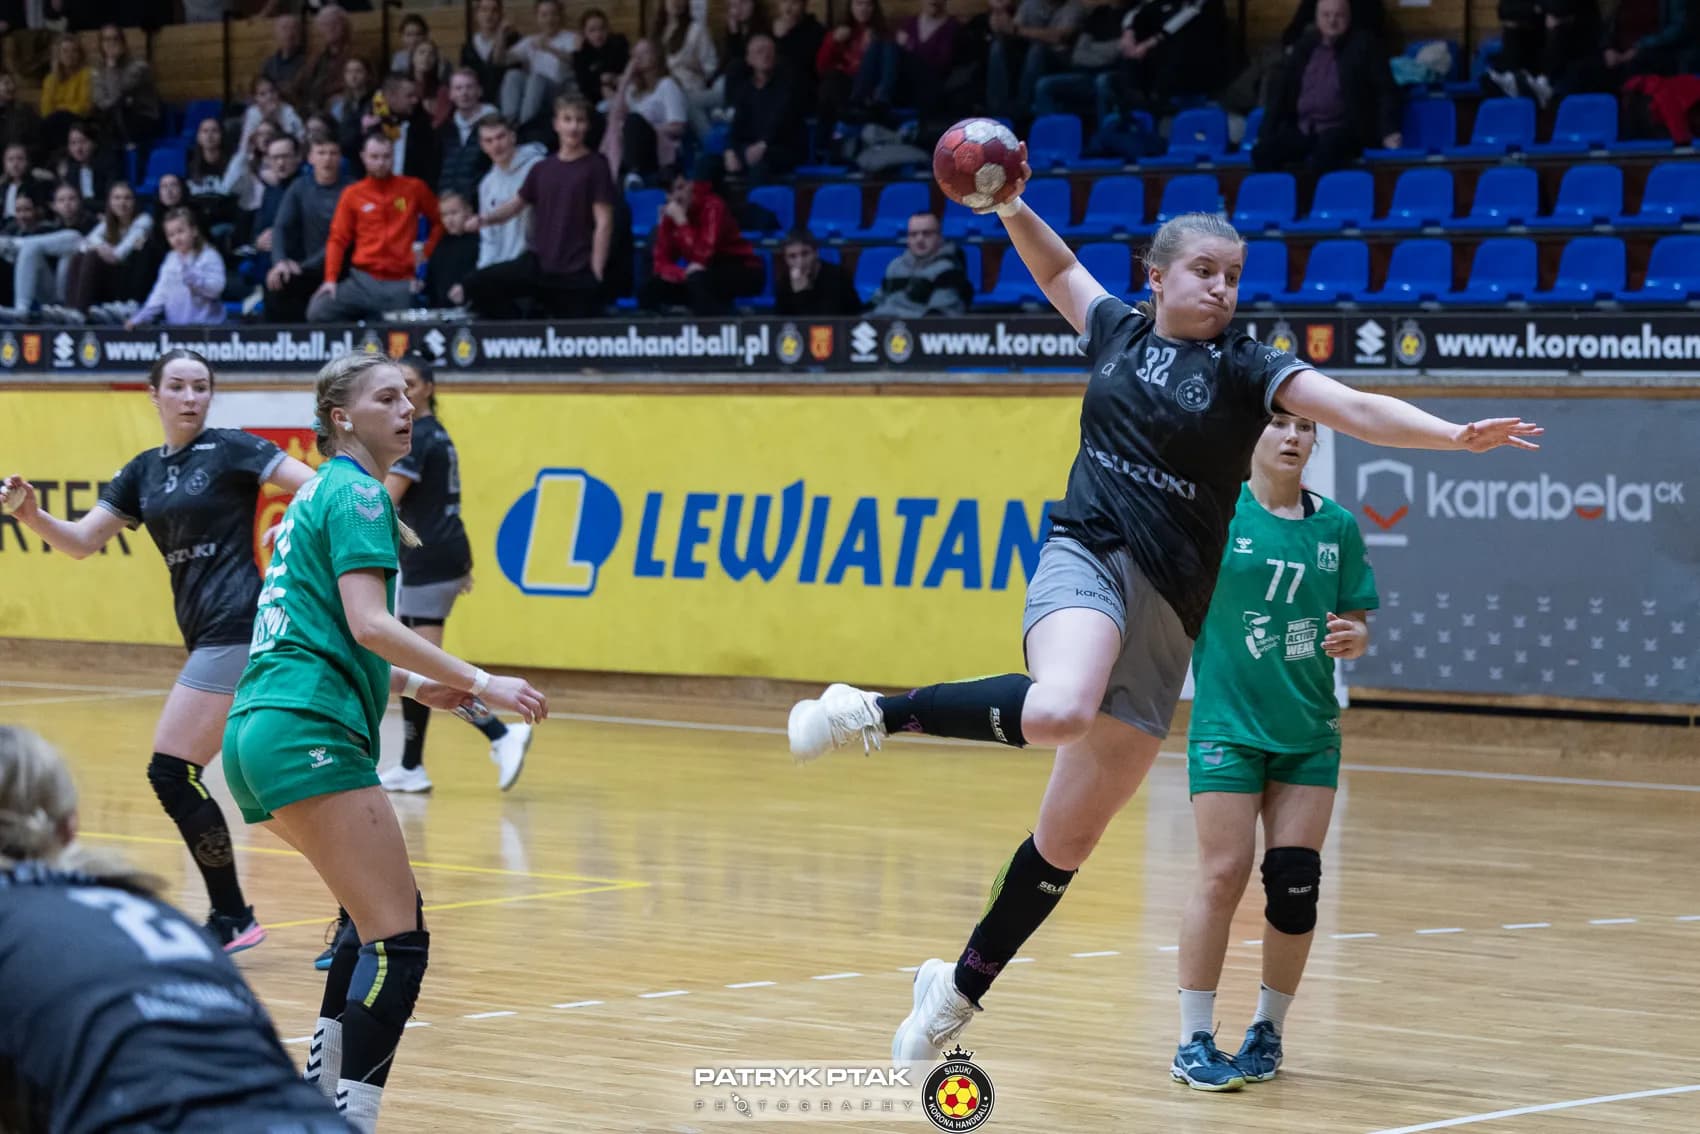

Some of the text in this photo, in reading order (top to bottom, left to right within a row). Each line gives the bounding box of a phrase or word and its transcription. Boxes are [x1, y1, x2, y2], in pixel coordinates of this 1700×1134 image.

[482, 325, 769, 366] www.koronahandball.pl
[1136, 346, 1177, 387] 32
[1095, 450, 1197, 500] SUZUKI
[1427, 471, 1686, 522] karabela CK
[633, 479, 1065, 591] LEWIATAN
[1076, 588, 1116, 607] karab
[1264, 558, 1306, 604] 77
